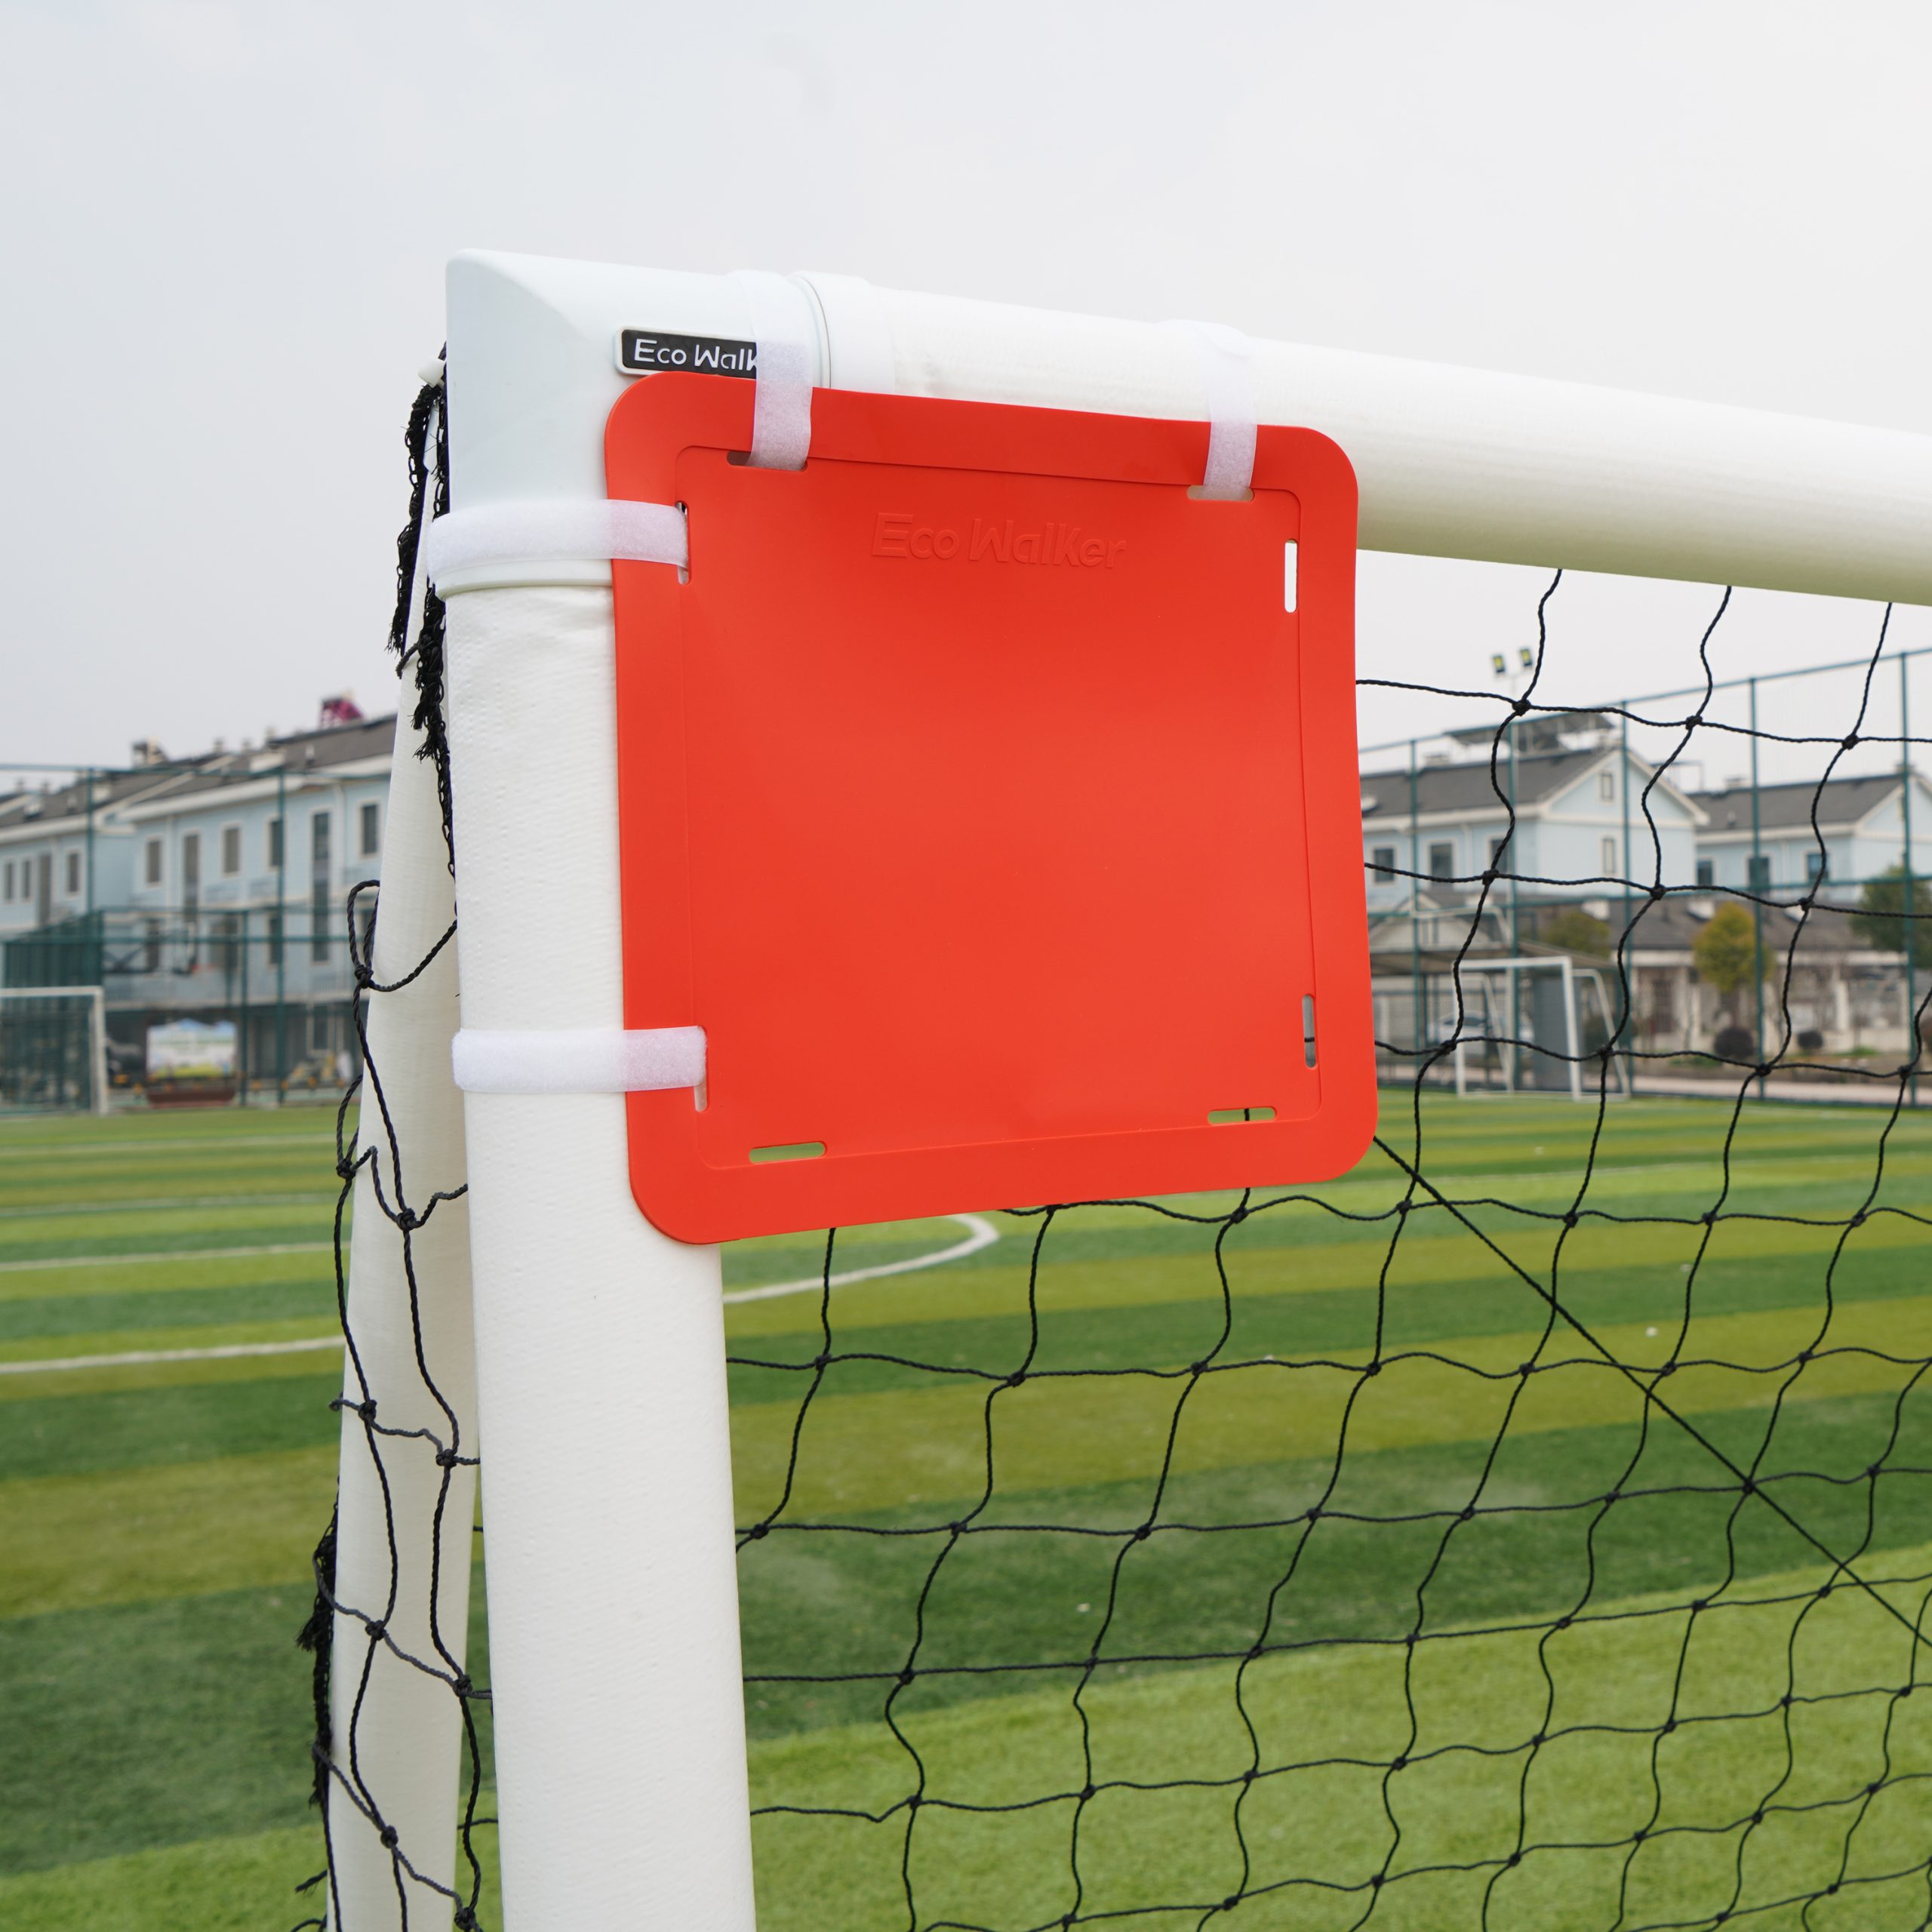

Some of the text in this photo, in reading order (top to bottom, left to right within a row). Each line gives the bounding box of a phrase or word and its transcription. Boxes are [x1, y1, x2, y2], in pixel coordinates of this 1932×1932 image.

[634, 338, 686, 365] Eco
[872, 512, 1127, 568] Eco Walker
